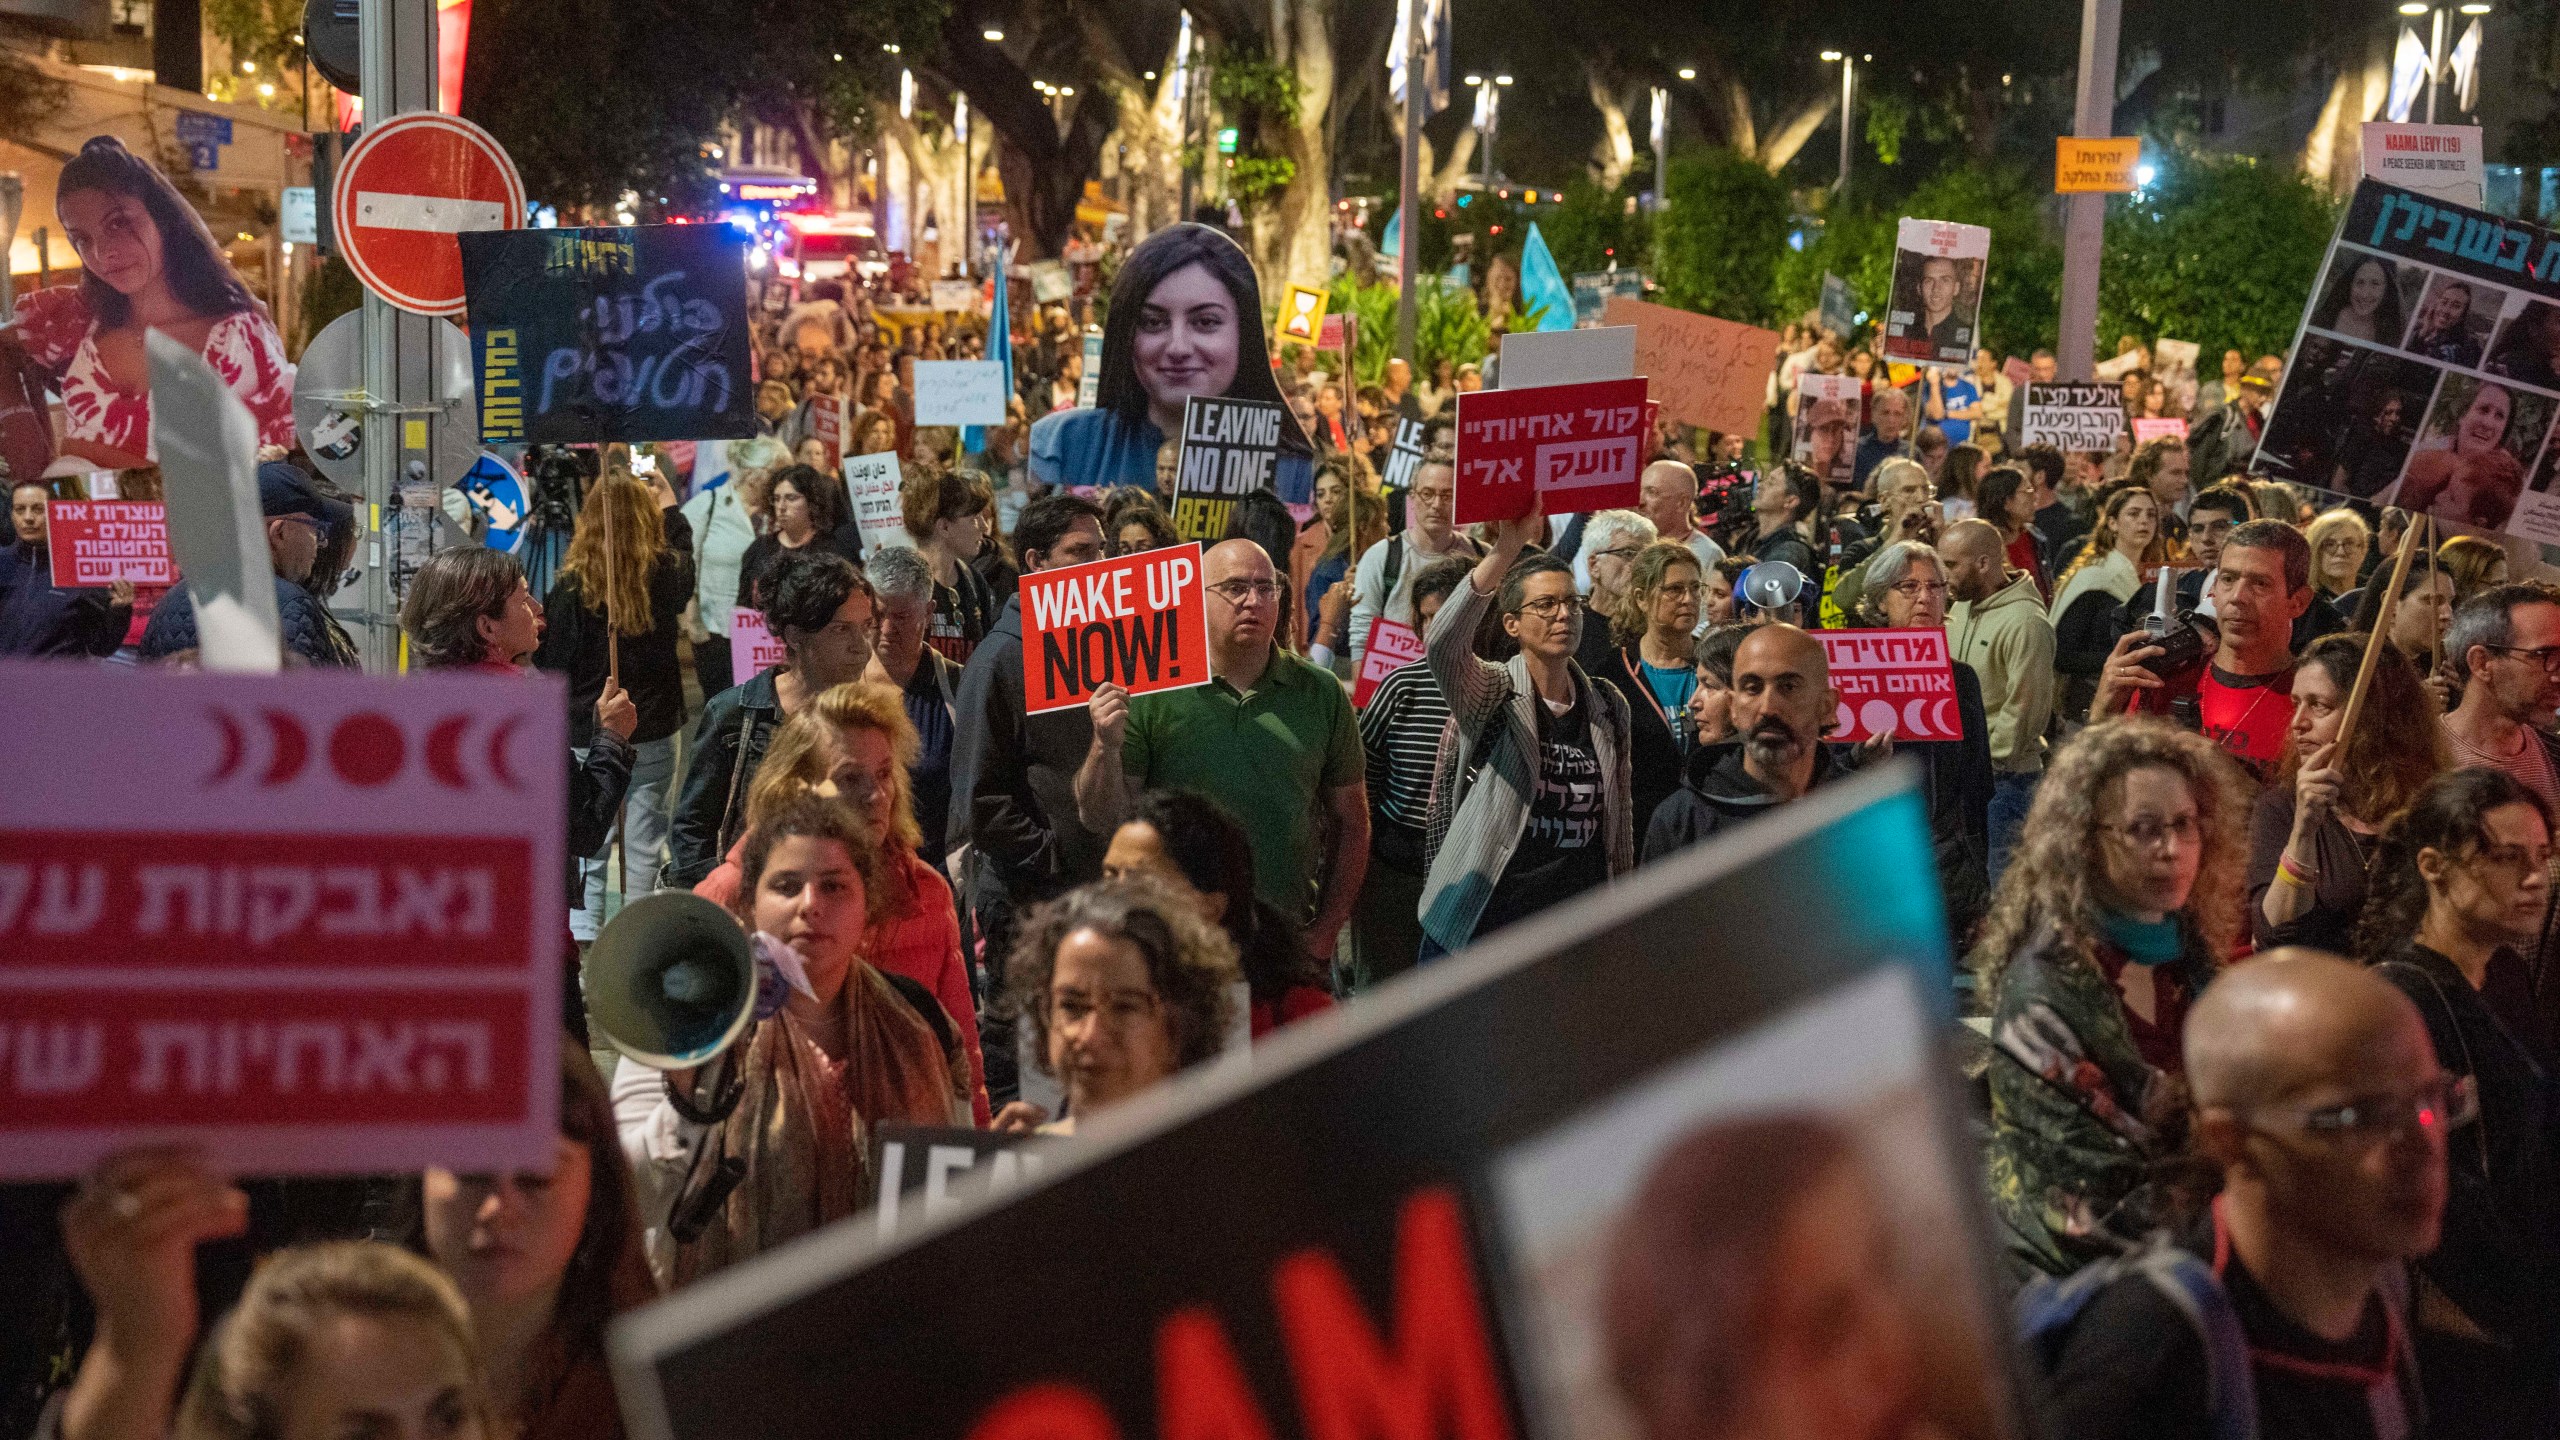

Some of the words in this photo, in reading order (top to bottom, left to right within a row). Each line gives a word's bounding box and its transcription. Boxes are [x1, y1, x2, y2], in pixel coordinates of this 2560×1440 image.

[2386, 134, 2418, 151] NAAMA
[2420, 136, 2440, 152] LEVY
[2370, 193, 2532, 273] בשבילן
[2032, 386, 2070, 408] קציר
[2071, 384, 2120, 406] אלעד
[1188, 402, 1282, 446] LEAVING
[1583, 406, 1639, 434] קול
[1180, 447, 1219, 493] NO
[1221, 450, 1276, 495] ONE
[1463, 457, 1523, 485] אלי
[1549, 446, 1626, 482] זועק
[55, 504, 88, 520] את
[93, 504, 165, 520] עוצרות
[1177, 498, 1240, 541] BEHI
[100, 523, 166, 539] העולם
[75, 540, 167, 556] החטופות
[80, 562, 112, 576] שם
[121, 562, 166, 576] עדיין
[1030, 566, 1135, 631] WAKE
[1145, 557, 1194, 611] UP
[753, 645, 785, 661] פות
[1042, 608, 1181, 701] NOW!
[1386, 632, 1425, 654] פקיר
[1826, 638, 1938, 663] מחזירו
[1886, 673, 1951, 693] אותם
[1566, 759, 1601, 775] צוה
[136, 864, 494, 946] נאבקות
[0, 1020, 103, 1094] ש
[131, 1020, 492, 1094] האחיות
